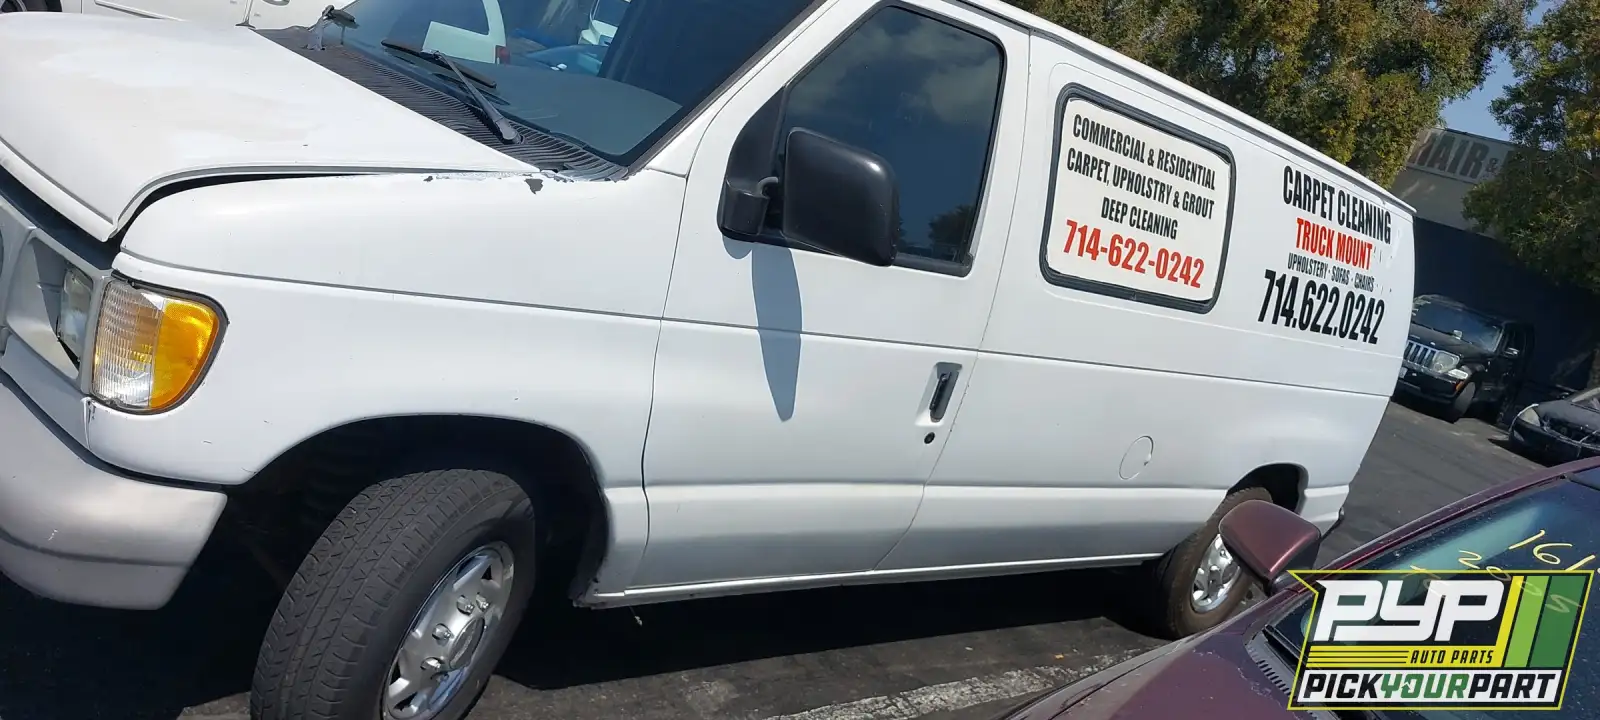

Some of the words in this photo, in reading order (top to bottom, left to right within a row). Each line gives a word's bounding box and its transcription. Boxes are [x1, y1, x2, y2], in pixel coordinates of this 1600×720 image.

[1067, 148, 1111, 186] CARPET,
[1112, 164, 1172, 205] UPHOLSTRY
[1173, 190, 1180, 208] &
[1182, 191, 1215, 220] GROUT
[1073, 114, 1145, 164] COMMERCIAL
[1147, 148, 1155, 167] &
[1157, 149, 1216, 190] RESIDENTIAL
[1407, 131, 1490, 179] HAIR
[1101, 197, 1128, 225] DEEP
[1129, 206, 1178, 240] CLEANING
[1283, 165, 1335, 221] CARPET
[1337, 190, 1391, 244] CLEANING
[1063, 219, 1205, 289] 714-622-0242
[1287, 252, 1328, 279] UPHOLSTERY
[1331, 265, 1350, 285] SOFAS
[1296, 217, 1335, 259] TRUCK
[1335, 231, 1373, 270] MOUNT
[1257, 269, 1385, 345] 714.622.0242
